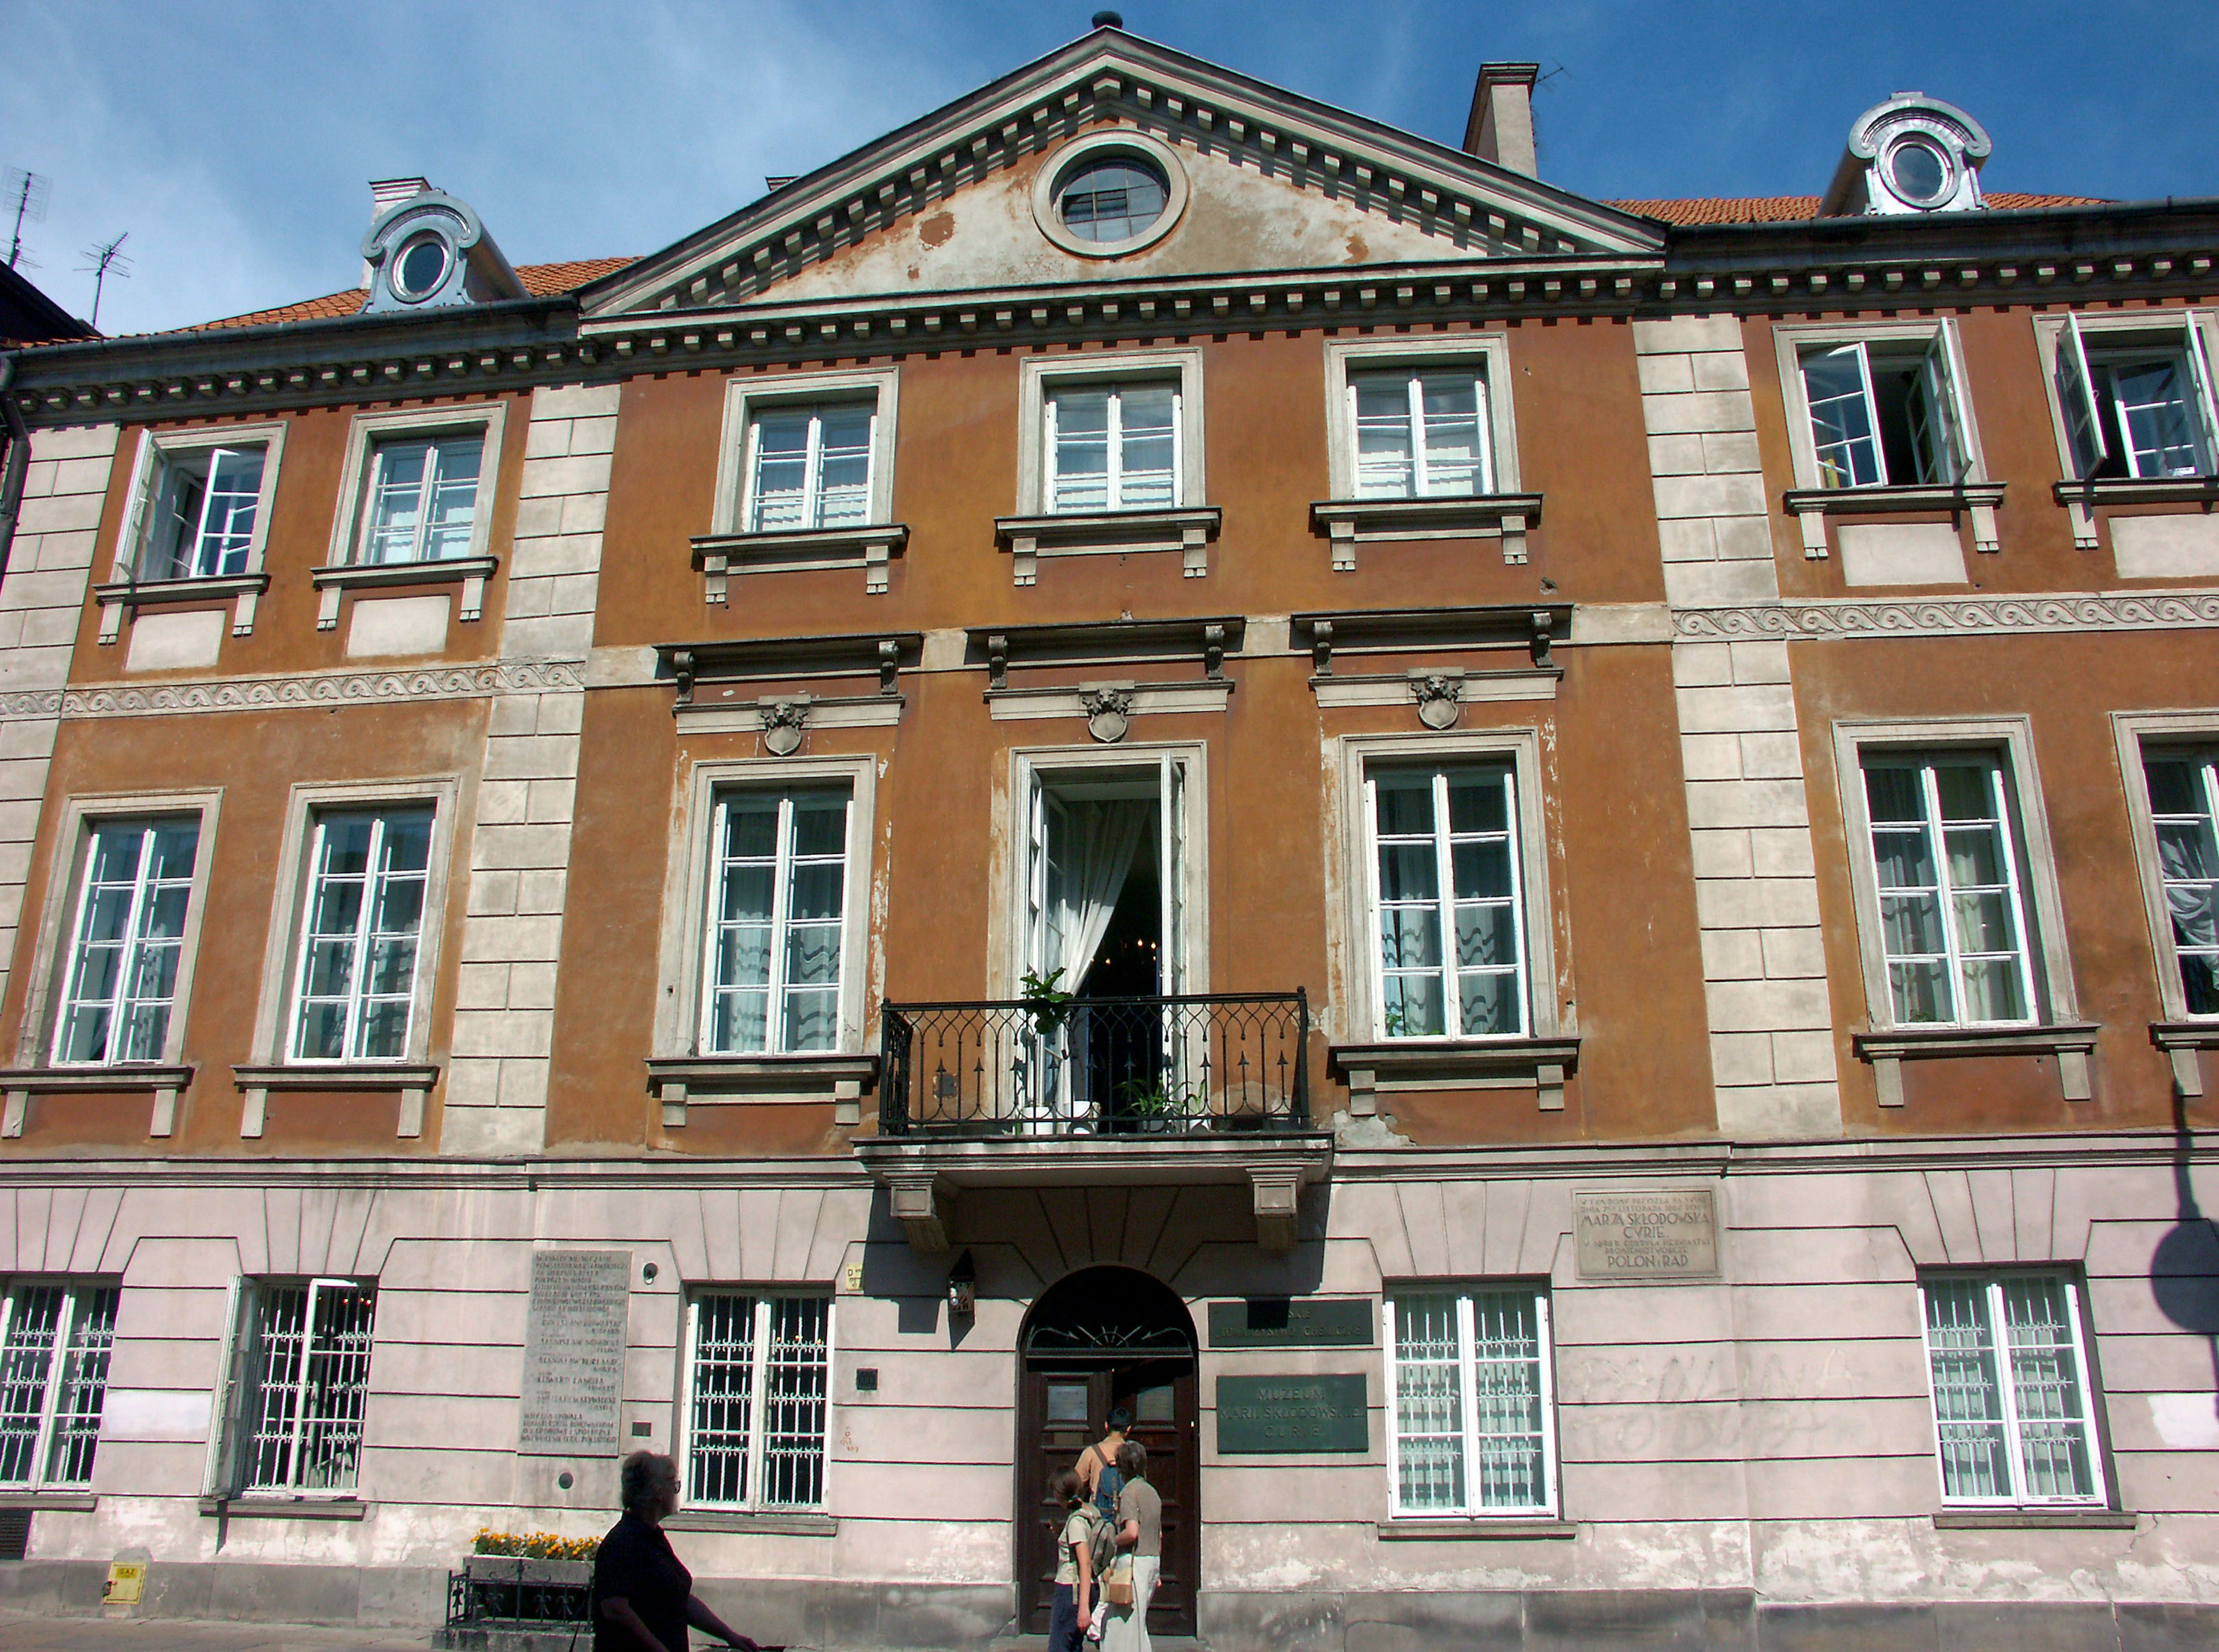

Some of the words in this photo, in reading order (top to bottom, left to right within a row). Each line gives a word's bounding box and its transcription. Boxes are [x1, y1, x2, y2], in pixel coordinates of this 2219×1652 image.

[1627, 1212, 1709, 1226] SKŁODOWSKA
[1608, 1254, 1656, 1268] POLON
[1662, 1254, 1689, 1267] RAD
[1258, 1387, 1324, 1401] MUZEUM
[1220, 1406, 1259, 1419] MARII
[1264, 1425, 1321, 1438] CURIE
